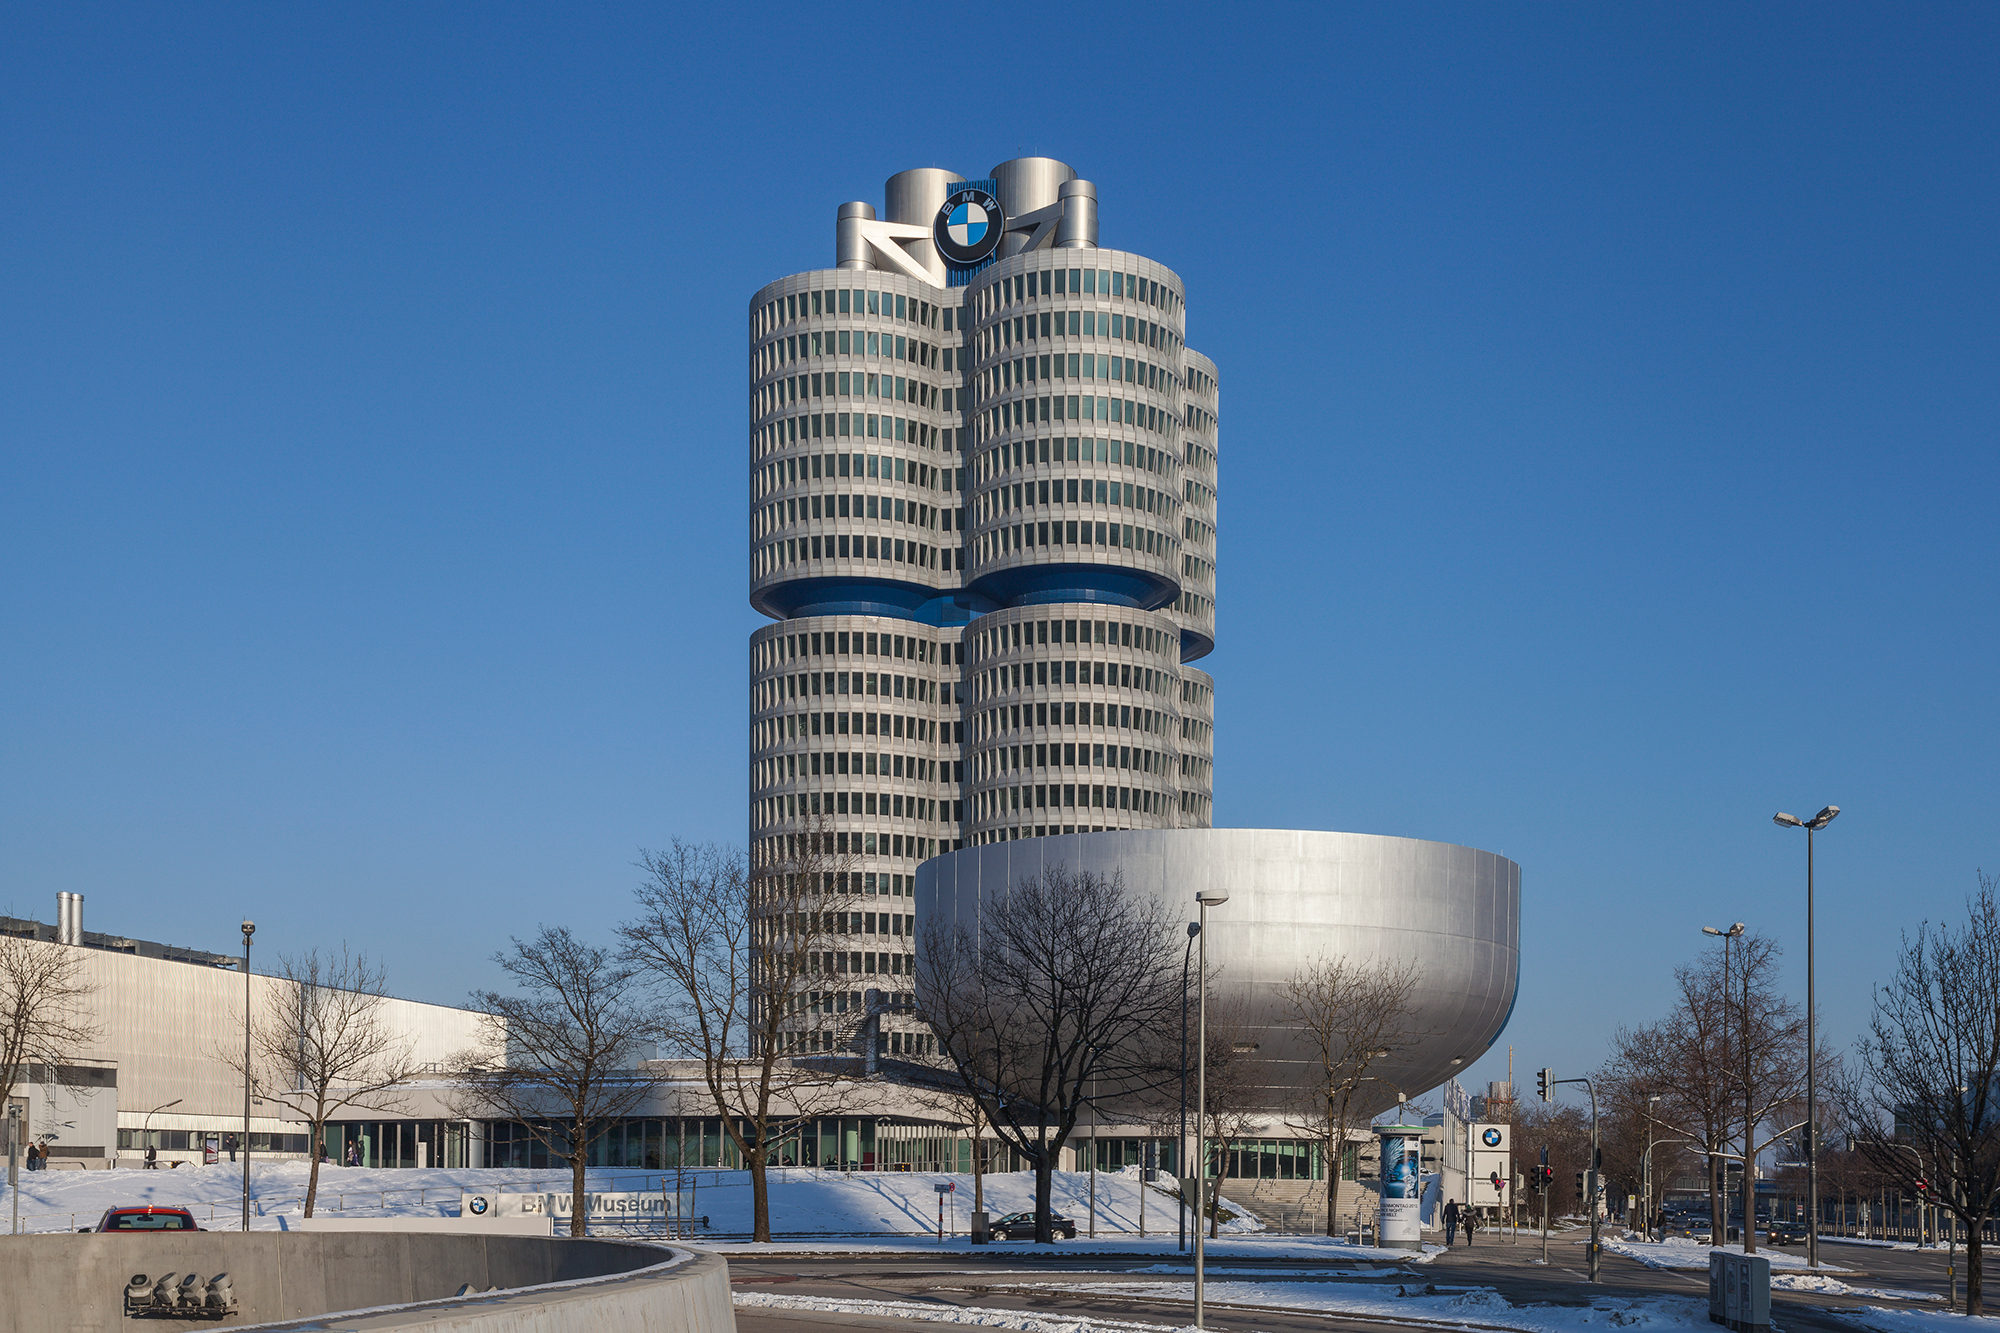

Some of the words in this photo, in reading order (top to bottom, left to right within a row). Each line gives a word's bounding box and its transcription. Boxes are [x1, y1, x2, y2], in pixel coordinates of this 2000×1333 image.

[941, 191, 997, 216] BMW
[522, 1195, 573, 1213] BMW
[585, 1195, 671, 1213] Museum
